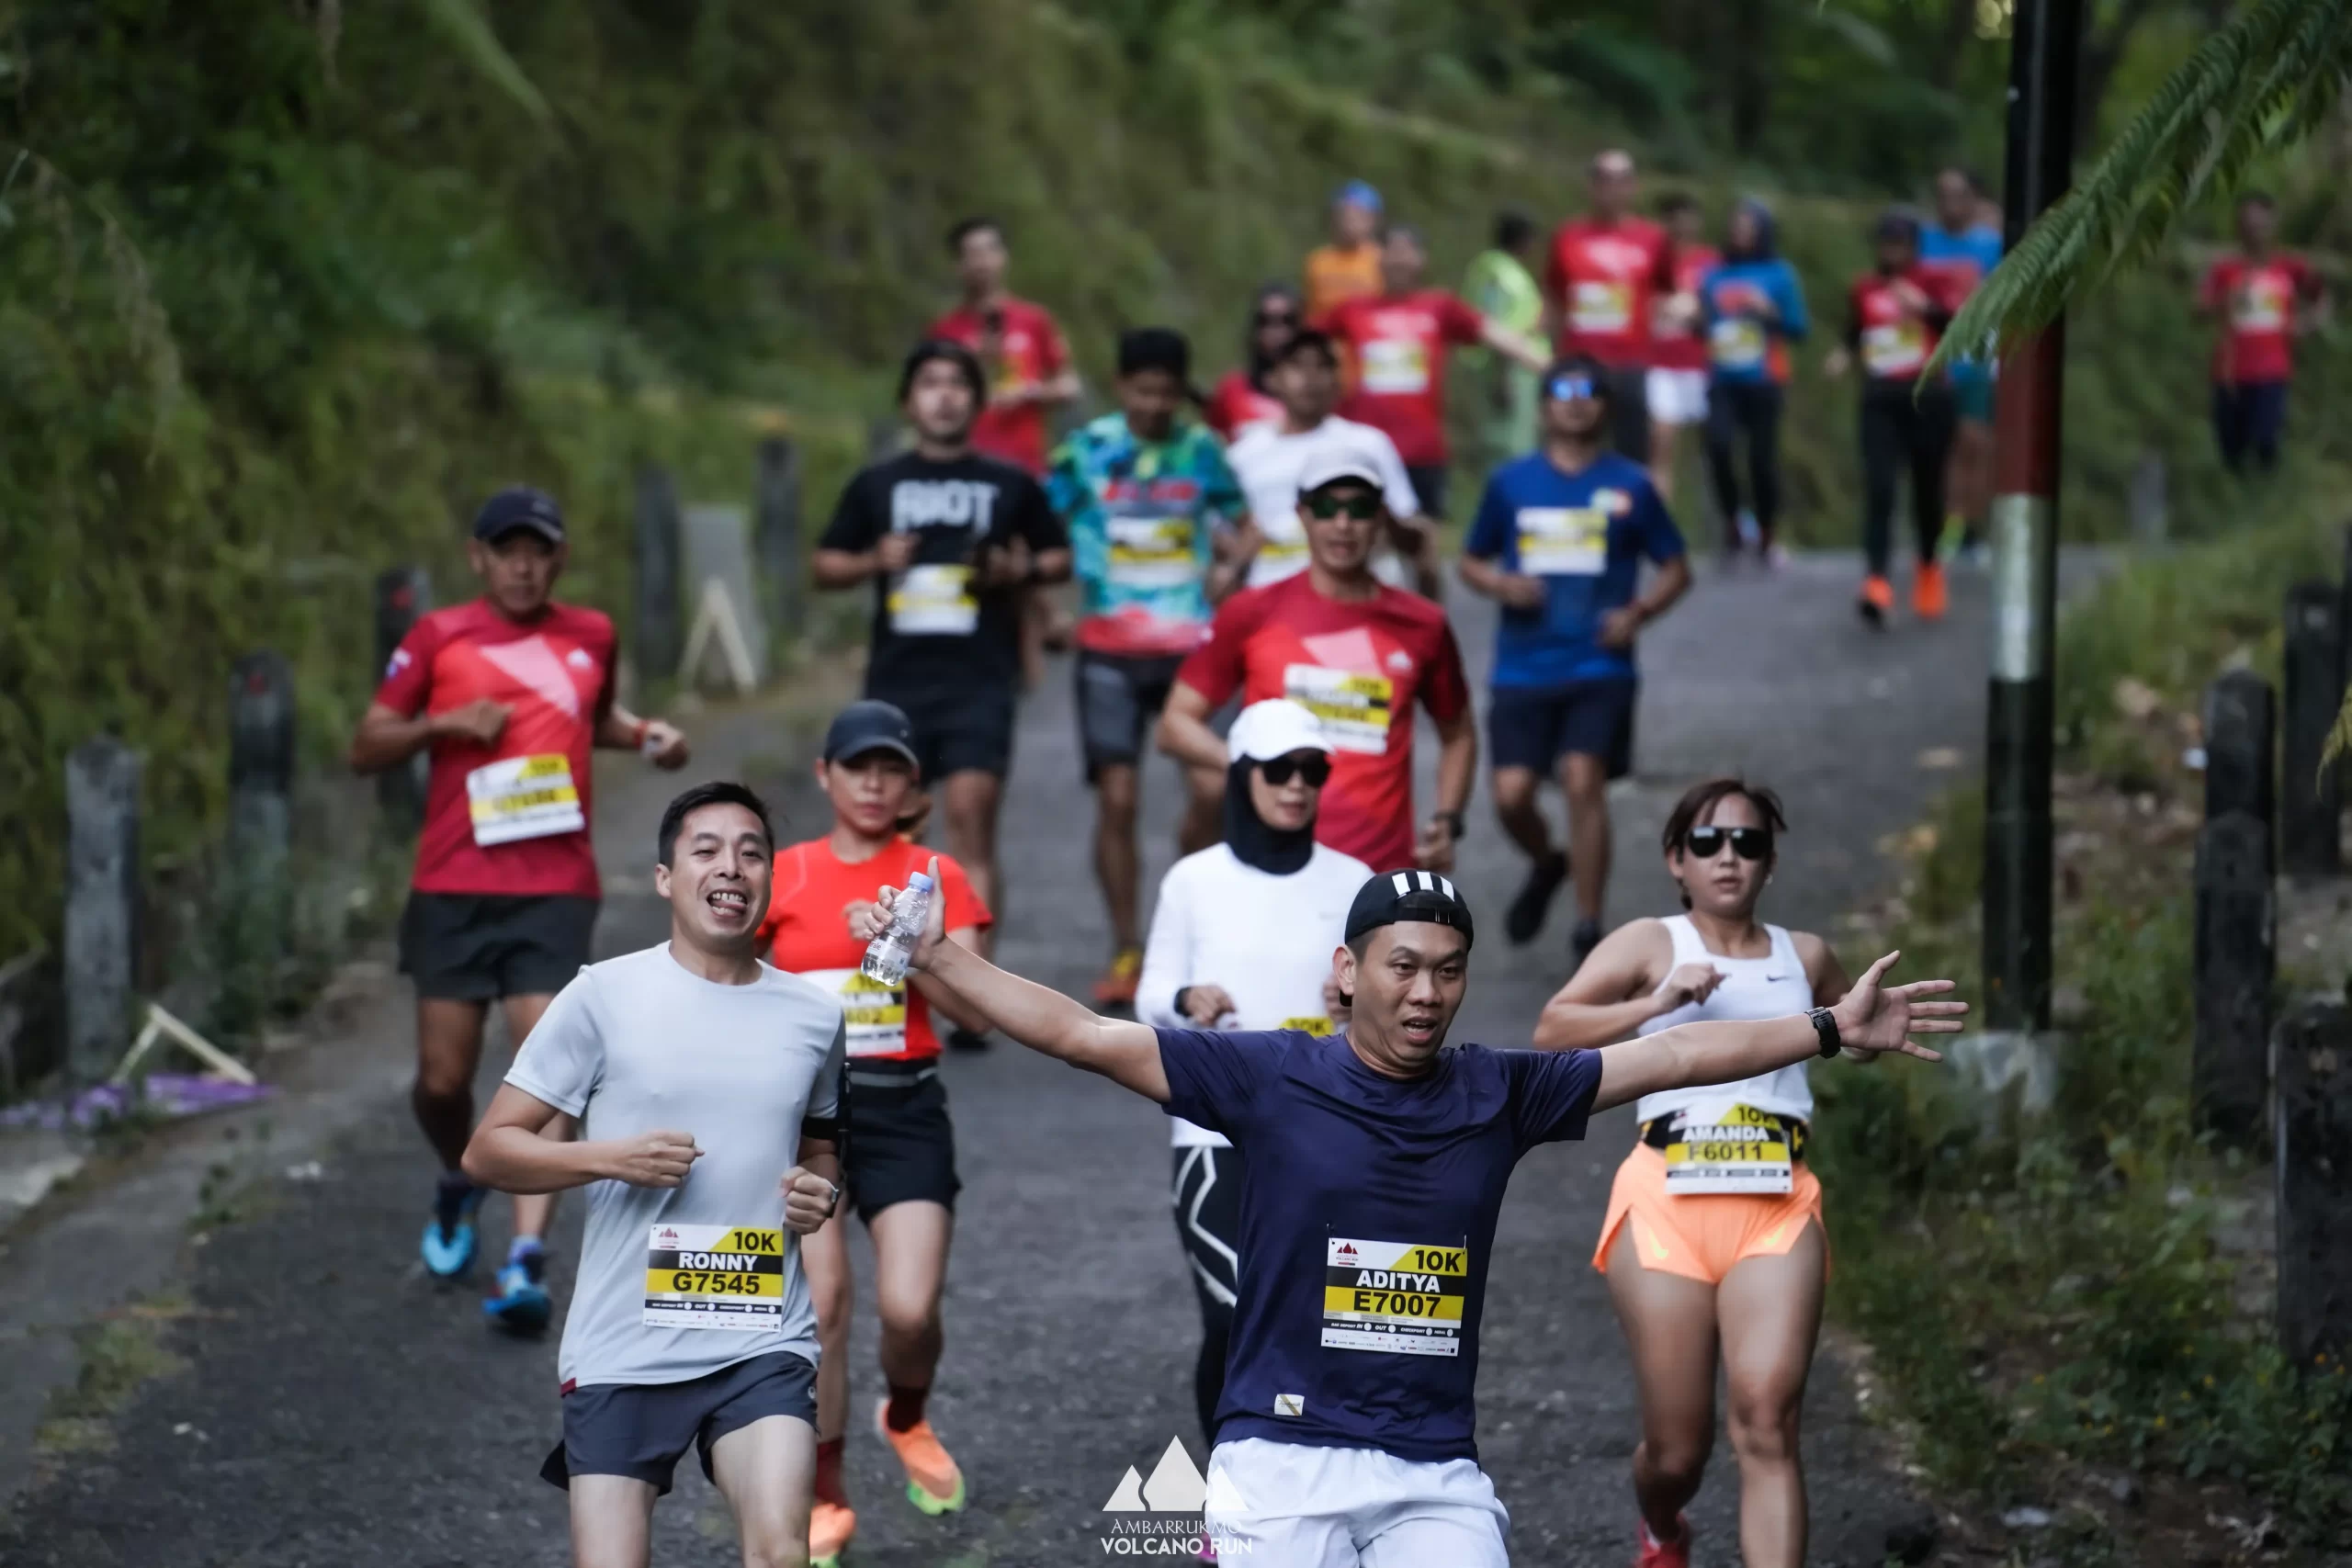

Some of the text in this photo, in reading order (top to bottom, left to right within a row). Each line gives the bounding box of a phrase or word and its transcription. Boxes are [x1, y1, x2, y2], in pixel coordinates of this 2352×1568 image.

[1681, 1126, 1770, 1142] AMANDA
[1689, 1143, 1762, 1161] F6011
[734, 1231, 776, 1252] 10K
[679, 1252, 758, 1271] RONNY
[1415, 1249, 1461, 1273] 10K
[673, 1272, 760, 1294] G7545
[1356, 1270, 1441, 1293] ADITYA
[1353, 1291, 1442, 1317] E7007
